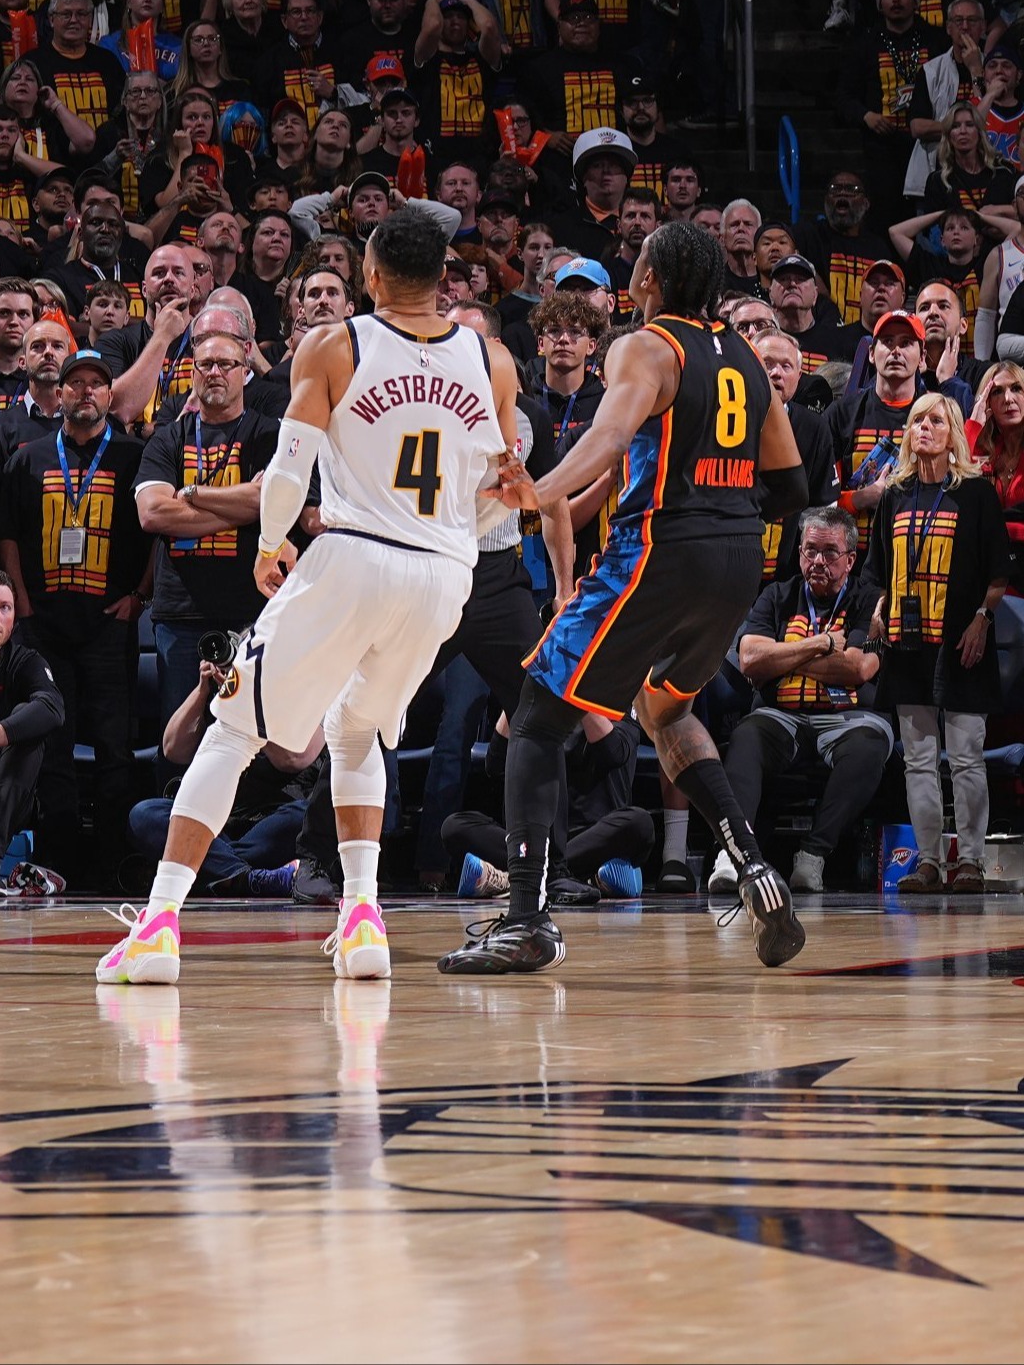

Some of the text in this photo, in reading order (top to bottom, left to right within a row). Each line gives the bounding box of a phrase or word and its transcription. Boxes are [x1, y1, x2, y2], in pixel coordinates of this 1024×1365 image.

[349, 374, 490, 432] WESTBROOK
[715, 367, 747, 449] 8
[392, 428, 444, 519] 4
[694, 457, 755, 489] WILLIAMS
